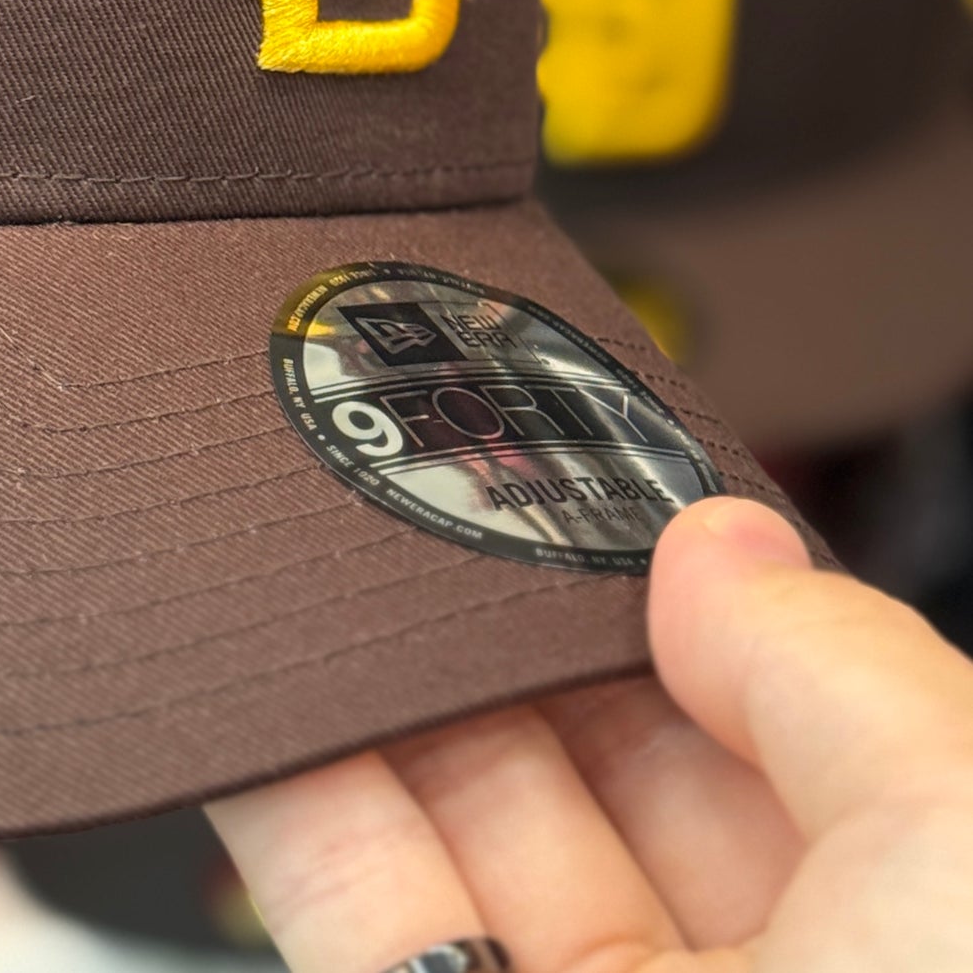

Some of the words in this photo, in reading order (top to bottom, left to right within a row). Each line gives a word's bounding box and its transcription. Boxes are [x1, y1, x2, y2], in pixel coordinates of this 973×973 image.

[439, 314, 502, 331] NEW
[457, 330, 518, 348] ERA
[293, 396, 306, 408] NY
[300, 412, 317, 431] USA
[326, 444, 355, 468] SINCE
[353, 467, 380, 486] 1920
[485, 477, 675, 511] ADJUSTABLE
[561, 506, 643, 524] A-FRAME
